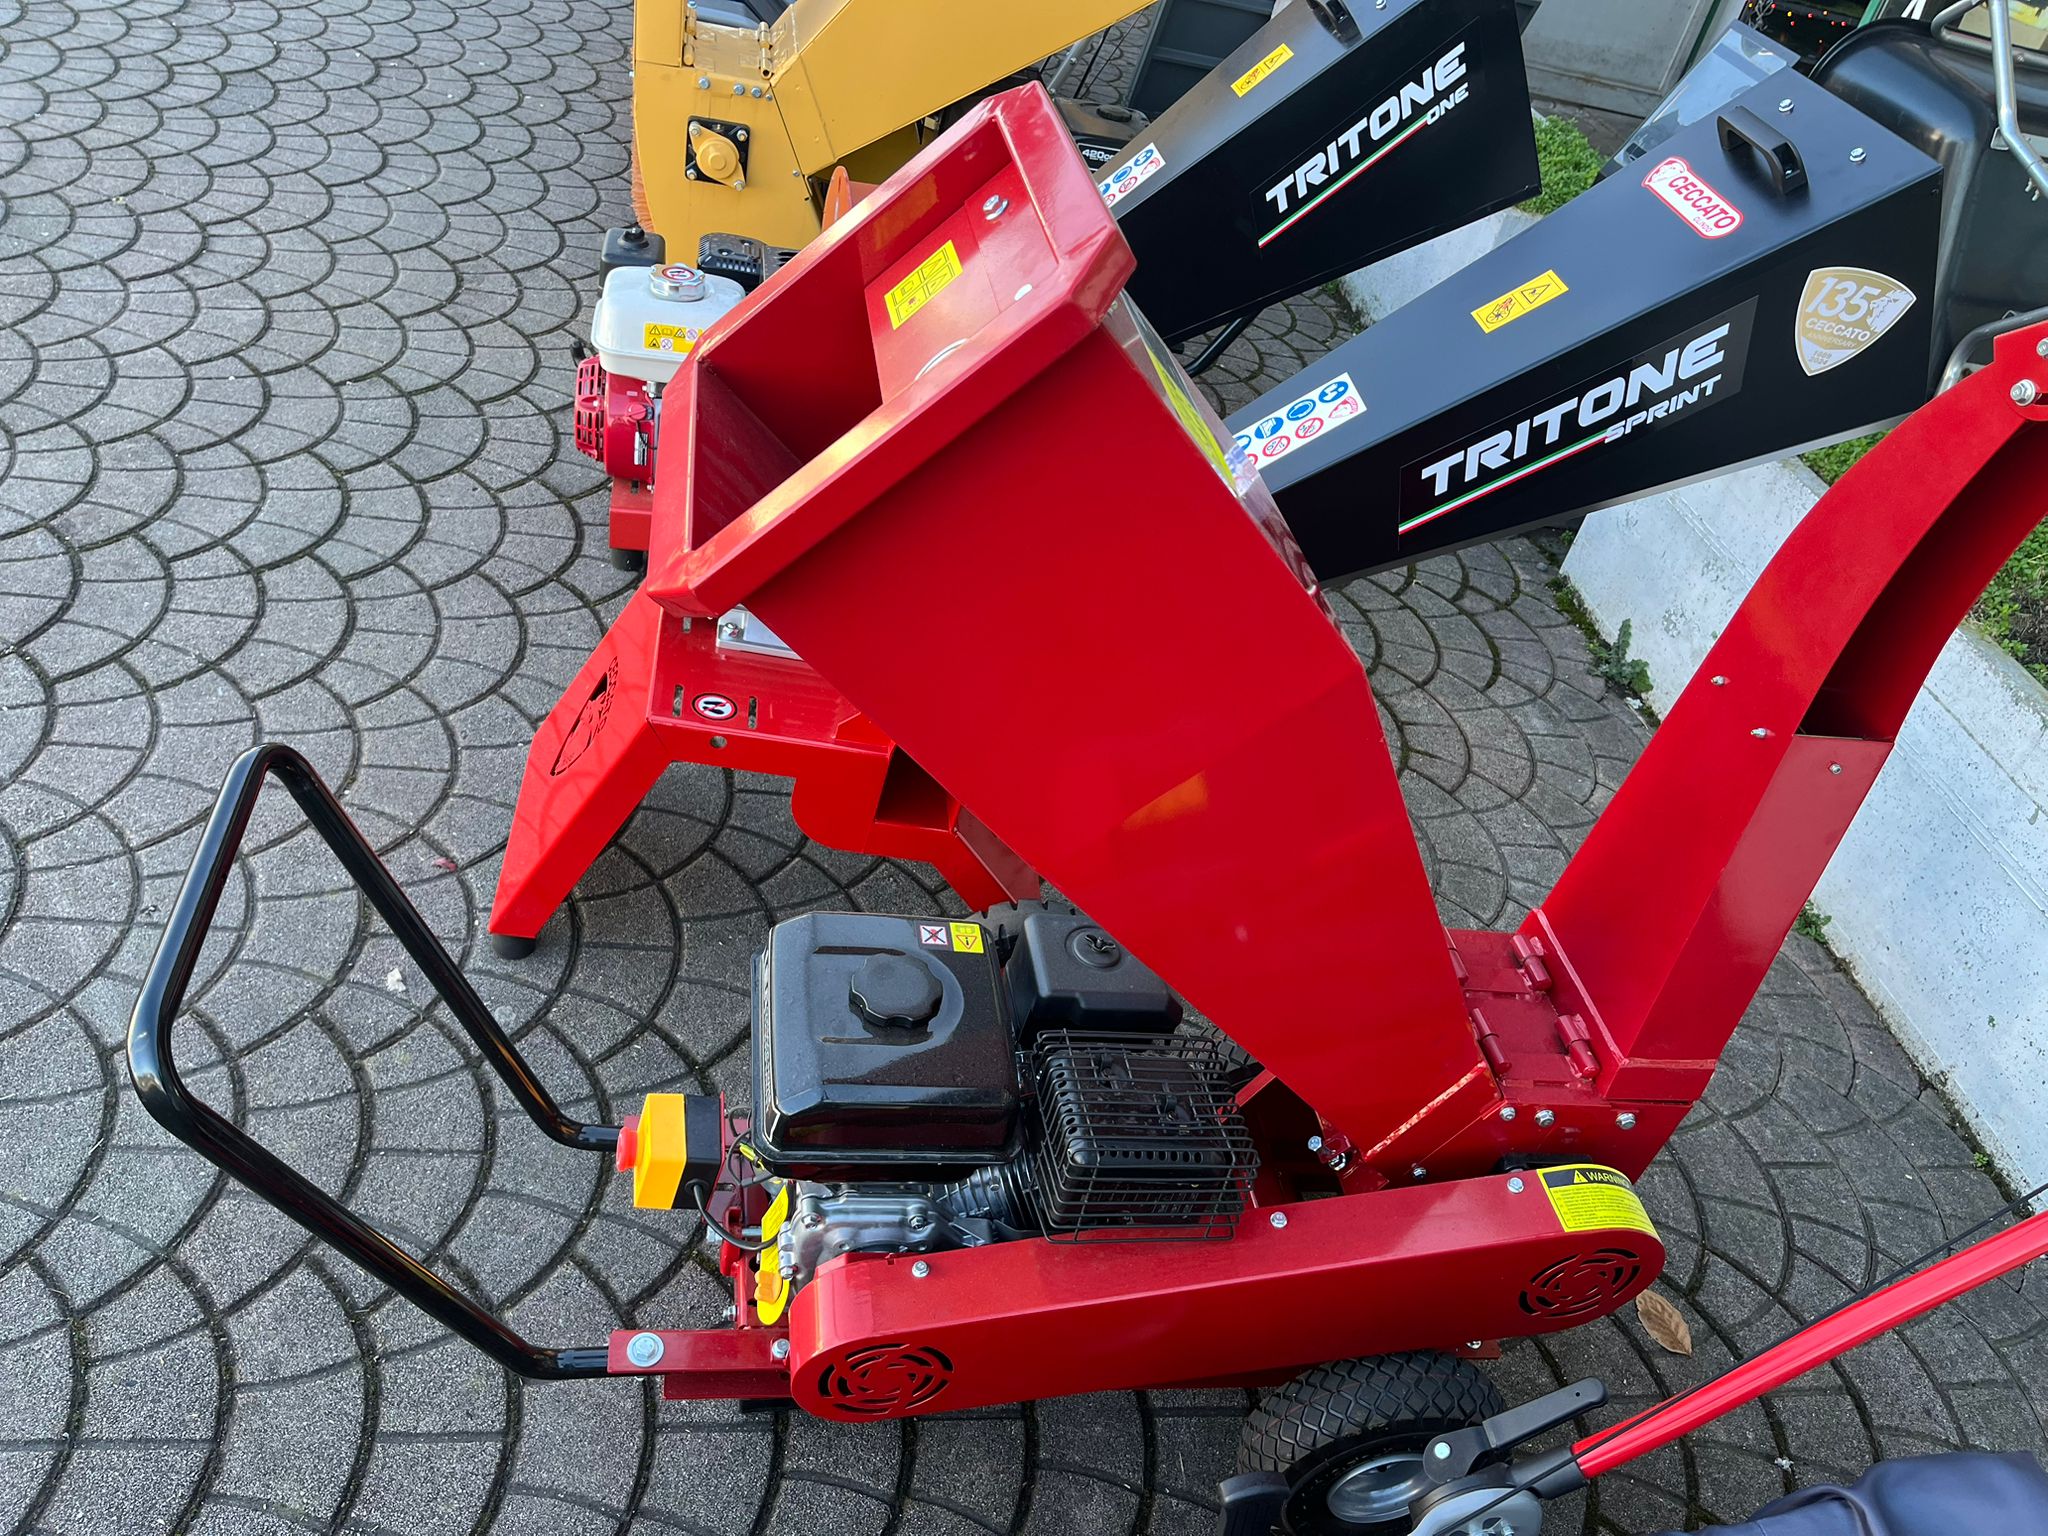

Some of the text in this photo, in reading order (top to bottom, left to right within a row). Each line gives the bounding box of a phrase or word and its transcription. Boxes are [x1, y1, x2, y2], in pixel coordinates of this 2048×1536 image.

[1265, 41, 1467, 214] TRITONE
[1426, 82, 1469, 125] ONE
[1668, 176, 1736, 229] CECCATO
[1806, 277, 1881, 322] 135
[1805, 317, 1871, 342] CECCATO
[1421, 322, 1730, 496] TRITONE
[1605, 374, 1722, 443] SPRINT
